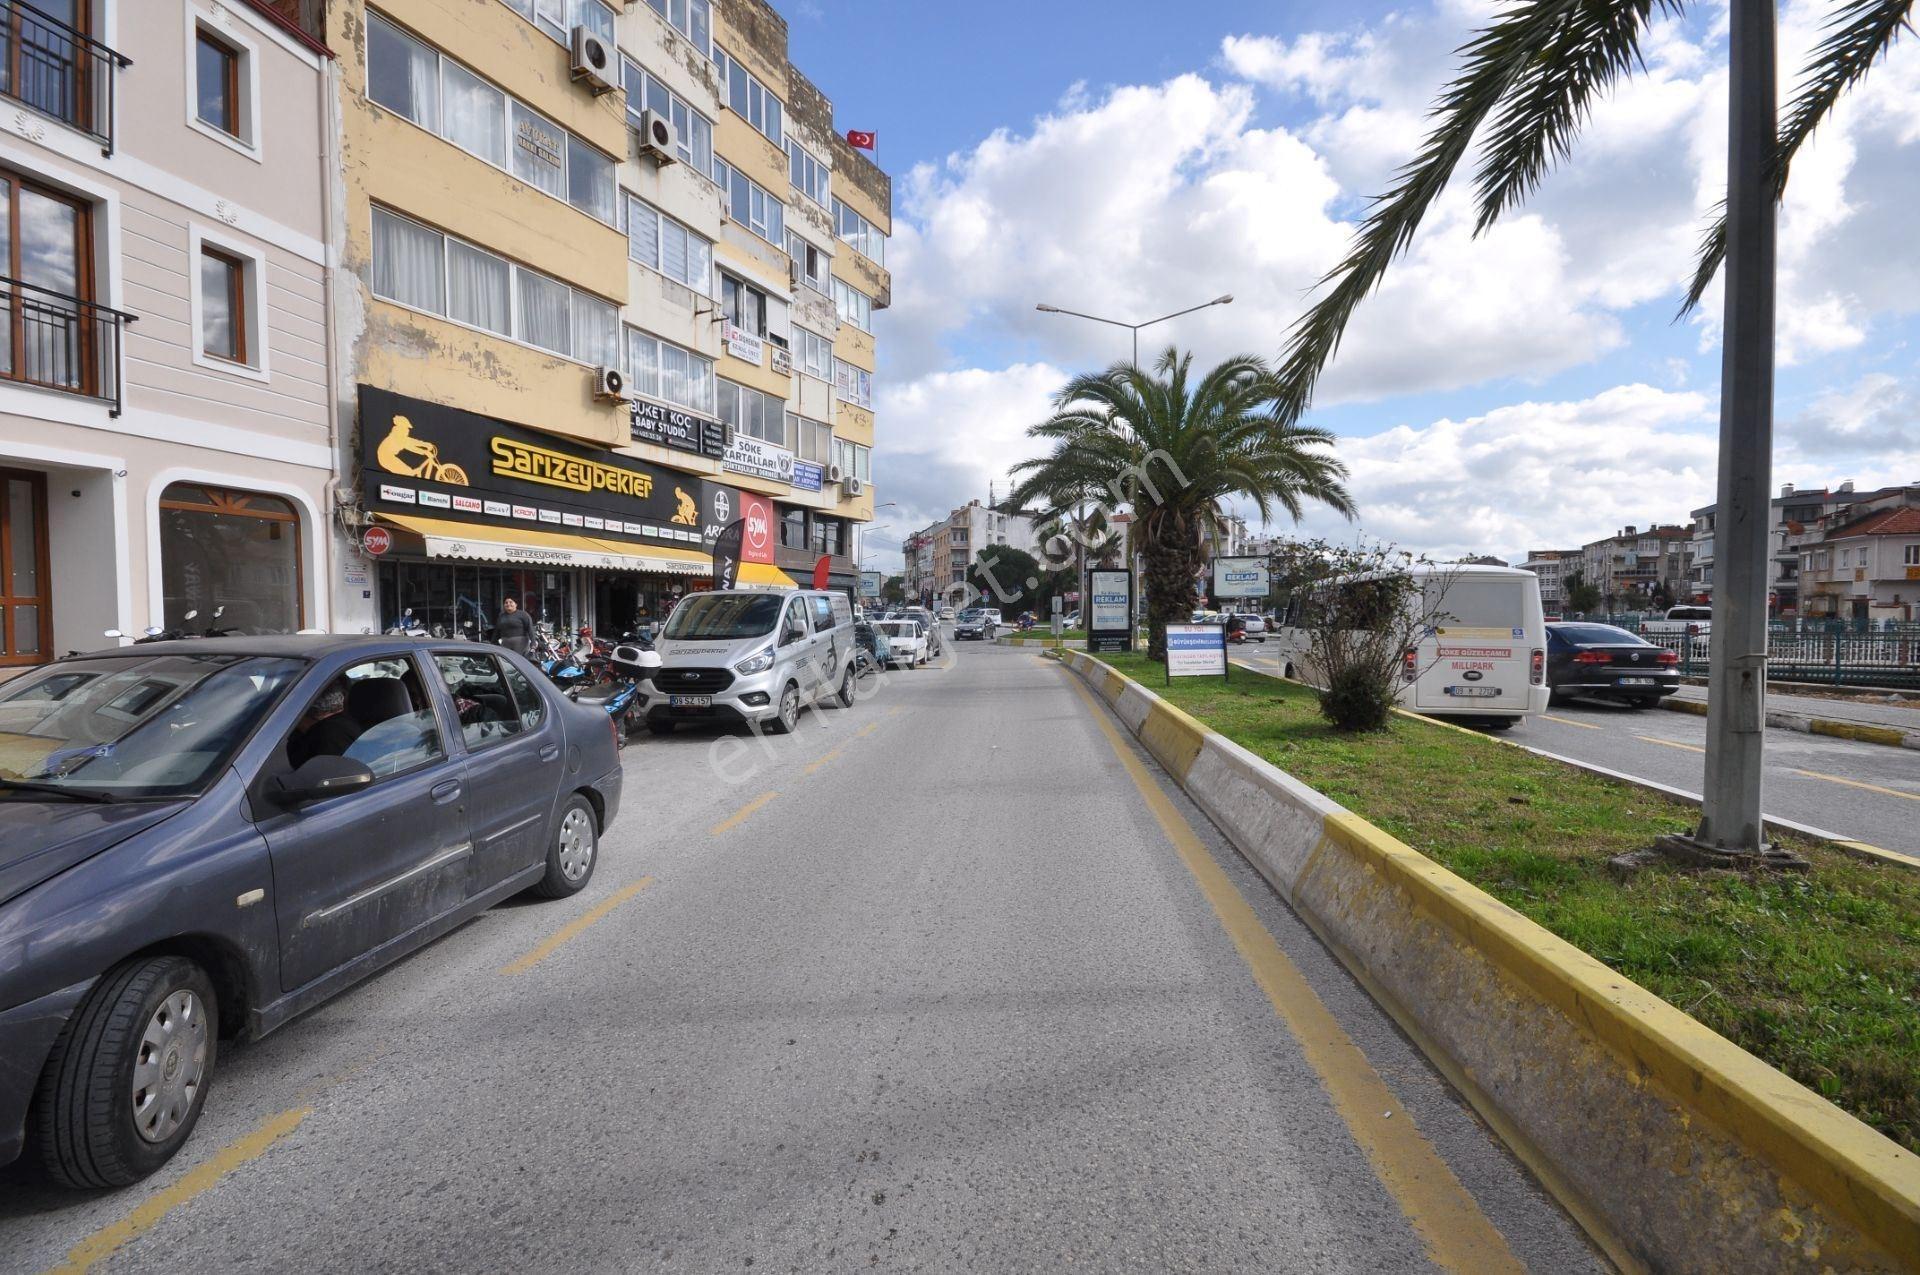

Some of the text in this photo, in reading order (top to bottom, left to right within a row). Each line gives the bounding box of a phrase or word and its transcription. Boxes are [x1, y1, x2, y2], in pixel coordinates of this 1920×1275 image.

[631, 400, 691, 431] BUKET KOÇ
[635, 416, 655, 430] BABY
[658, 423, 687, 438] STUDIO
[739, 441, 762, 455] SÖKE
[722, 448, 777, 469] KARTALLARI
[455, 500, 480, 509] SALCANO
[749, 517, 766, 537] SYM
[365, 536, 388, 548] SYM
[1226, 573, 1257, 581] REKLAM
